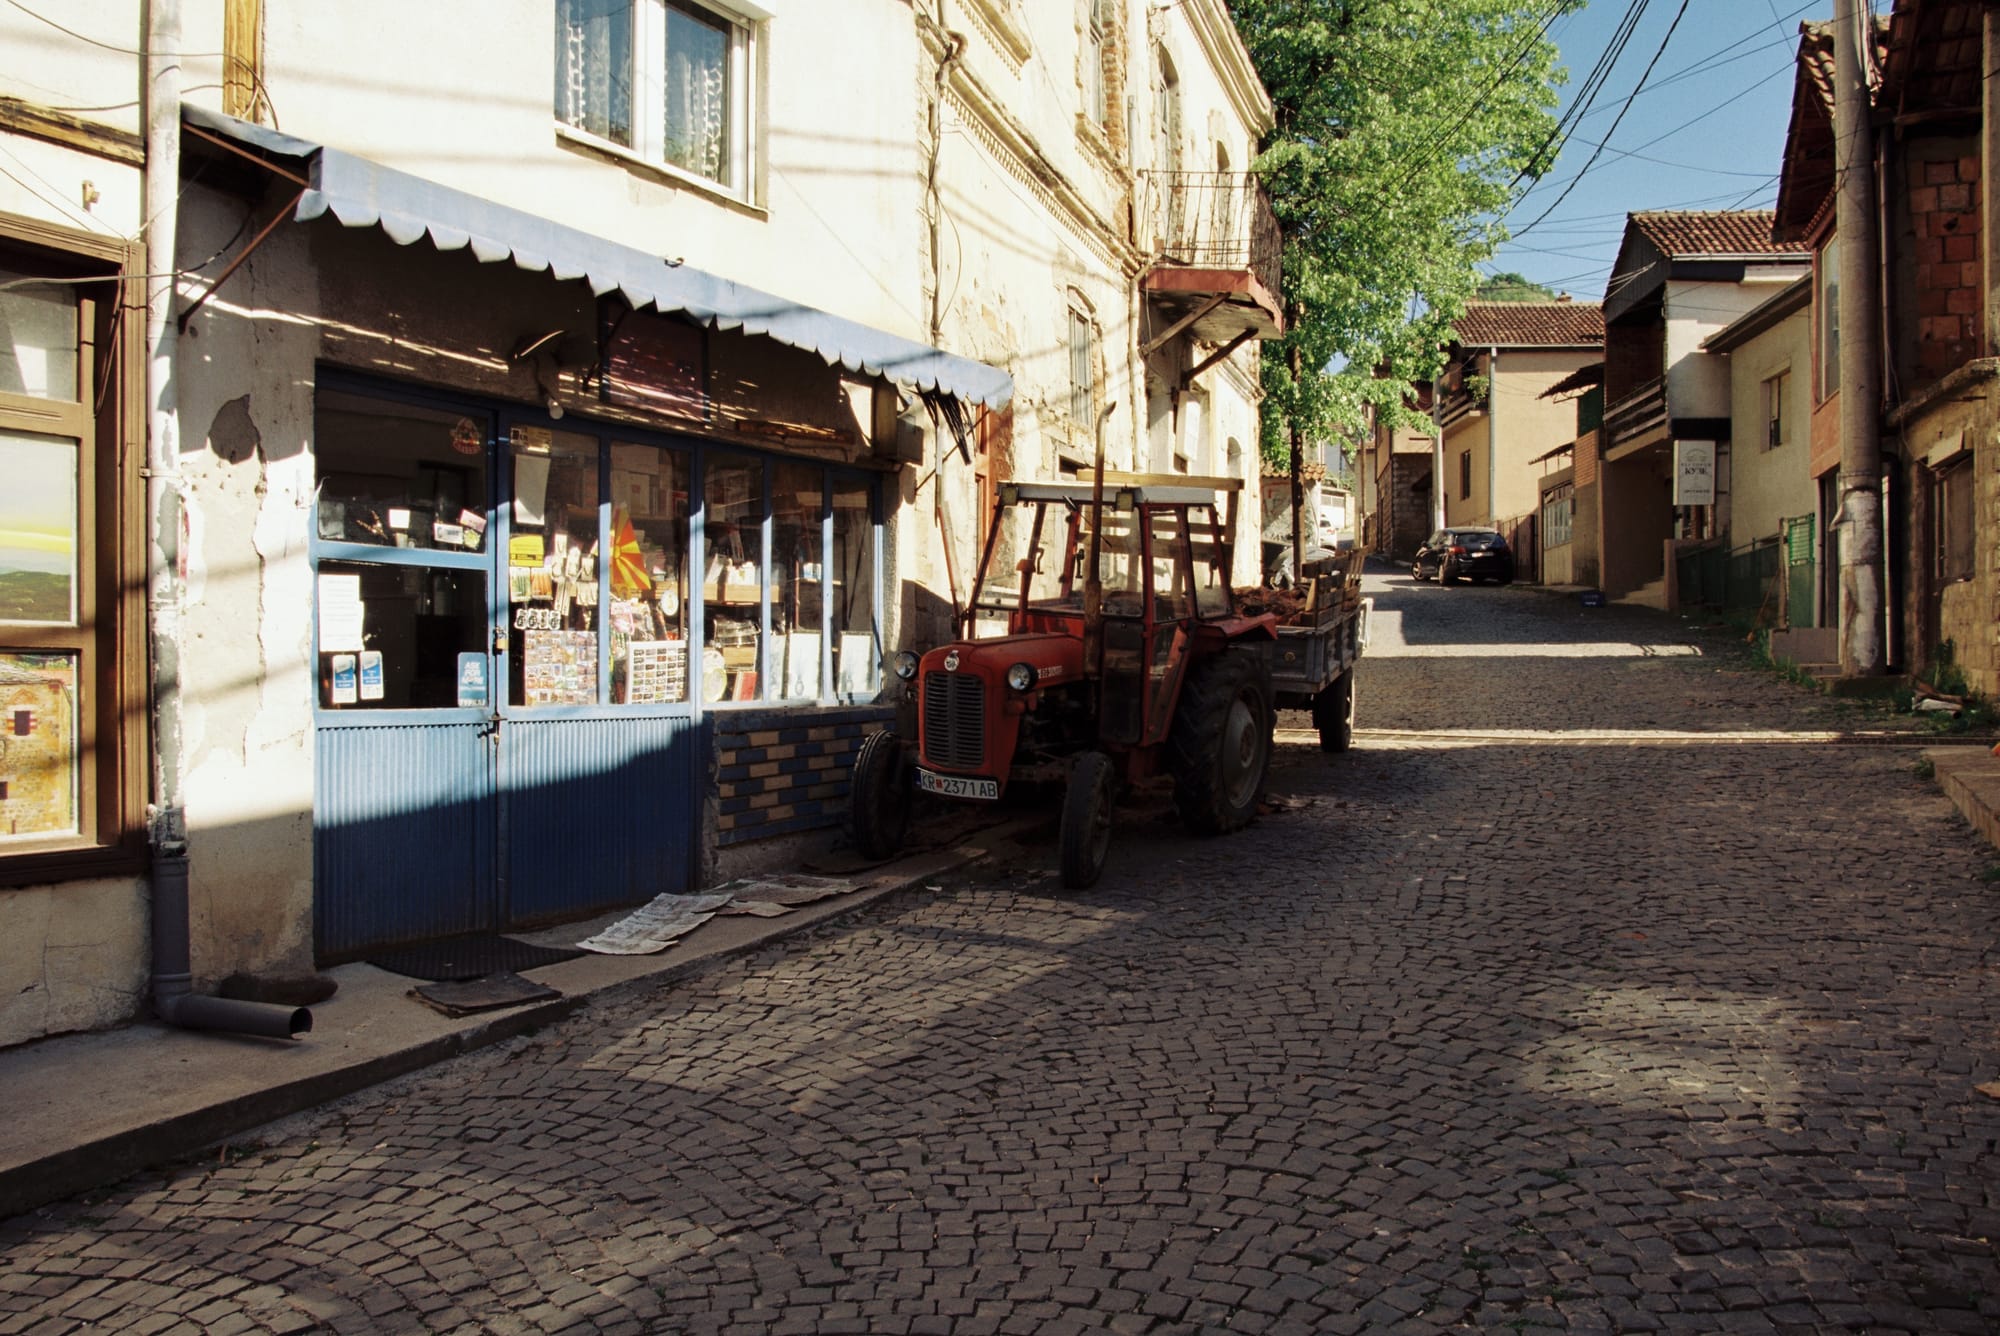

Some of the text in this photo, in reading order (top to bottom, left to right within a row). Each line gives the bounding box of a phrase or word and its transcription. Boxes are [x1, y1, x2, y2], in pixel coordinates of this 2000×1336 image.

[922, 773, 996, 797] KR 2371 AB
